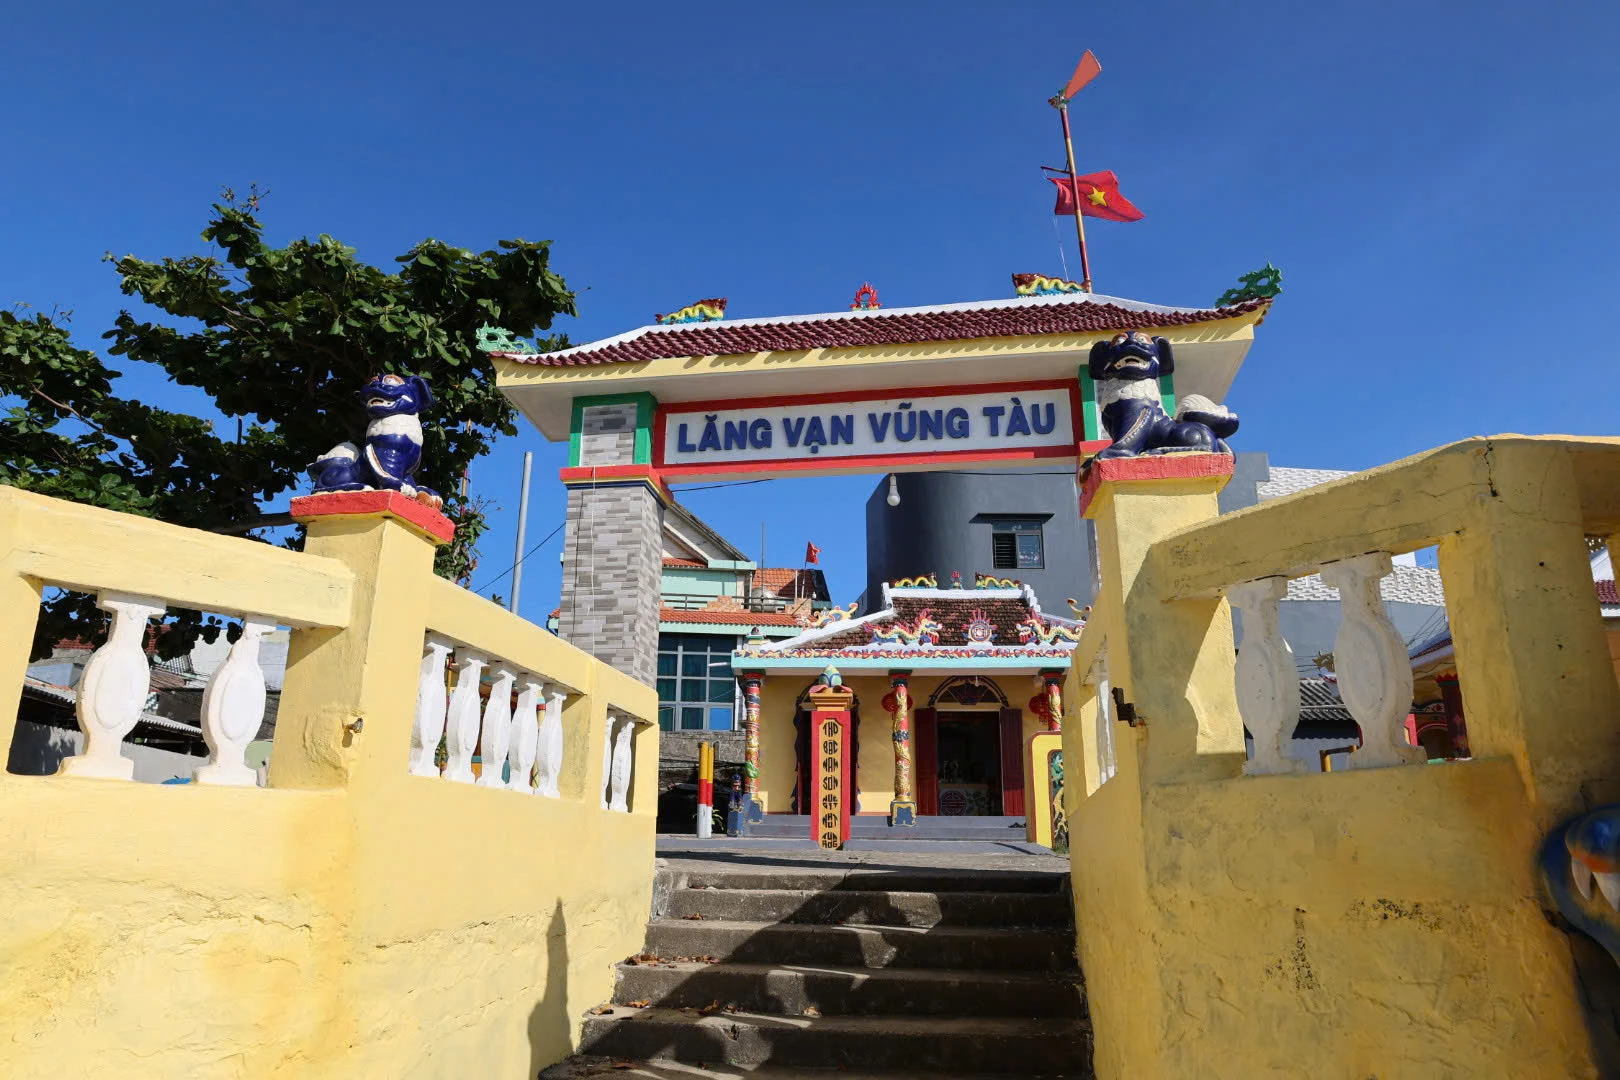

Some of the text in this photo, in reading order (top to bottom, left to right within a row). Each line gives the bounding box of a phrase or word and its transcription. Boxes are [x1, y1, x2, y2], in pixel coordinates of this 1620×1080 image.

[677, 397, 1056, 454] LĂNG VẠN VŨNG TÀU
